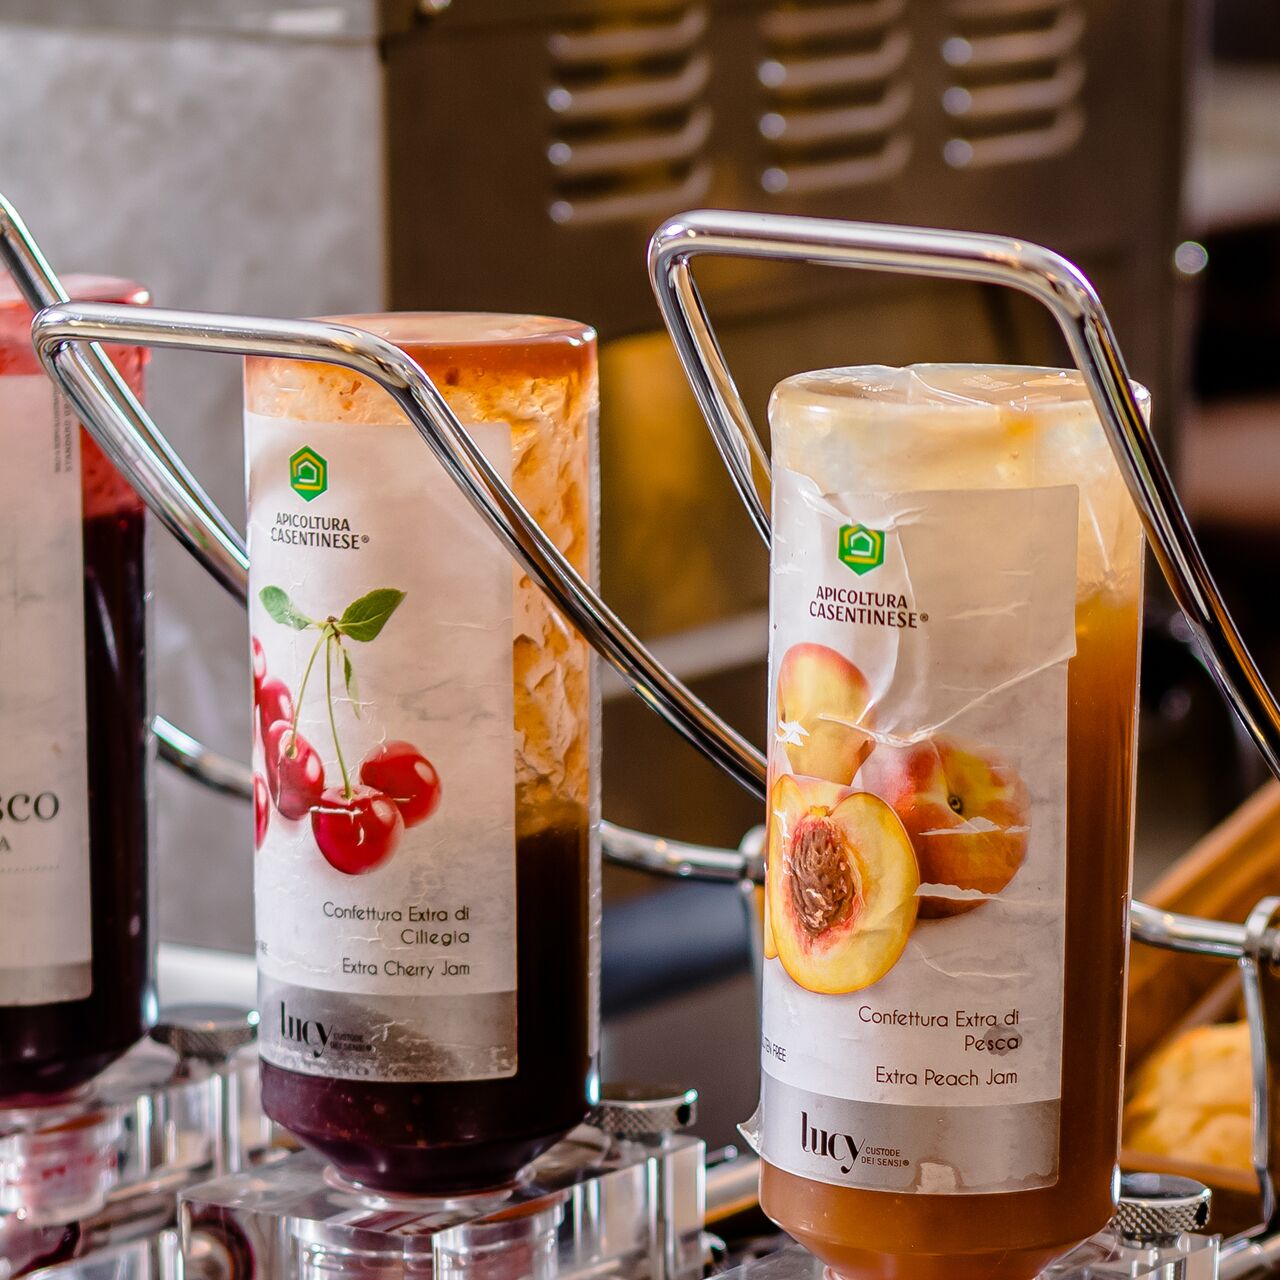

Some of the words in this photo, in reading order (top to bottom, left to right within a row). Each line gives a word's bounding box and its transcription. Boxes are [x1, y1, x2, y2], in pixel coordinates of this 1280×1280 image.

[275, 511, 351, 533] APICOLTURA
[815, 584, 908, 610] APICOLTURA
[322, 900, 403, 923] Confettura
[407, 905, 449, 923] Extra
[454, 904, 471, 922] di
[400, 927, 471, 947] Ciliegia
[341, 957, 379, 976] Extra
[382, 960, 436, 980] Cherry
[440, 960, 471, 977] Jam
[857, 1005, 949, 1028] Confettura
[954, 1010, 998, 1028] Extra
[1003, 1009, 1020, 1026] di
[279, 1000, 334, 1059] lucy
[964, 1034, 1020, 1052] Pesca
[875, 1065, 918, 1086] Extra
[924, 1068, 979, 1087] Peach
[985, 1069, 1018, 1086] Jam
[800, 1110, 866, 1175] lucy
[865, 1146, 901, 1157] CUSTODE
[861, 1156, 875, 1165] DEI
